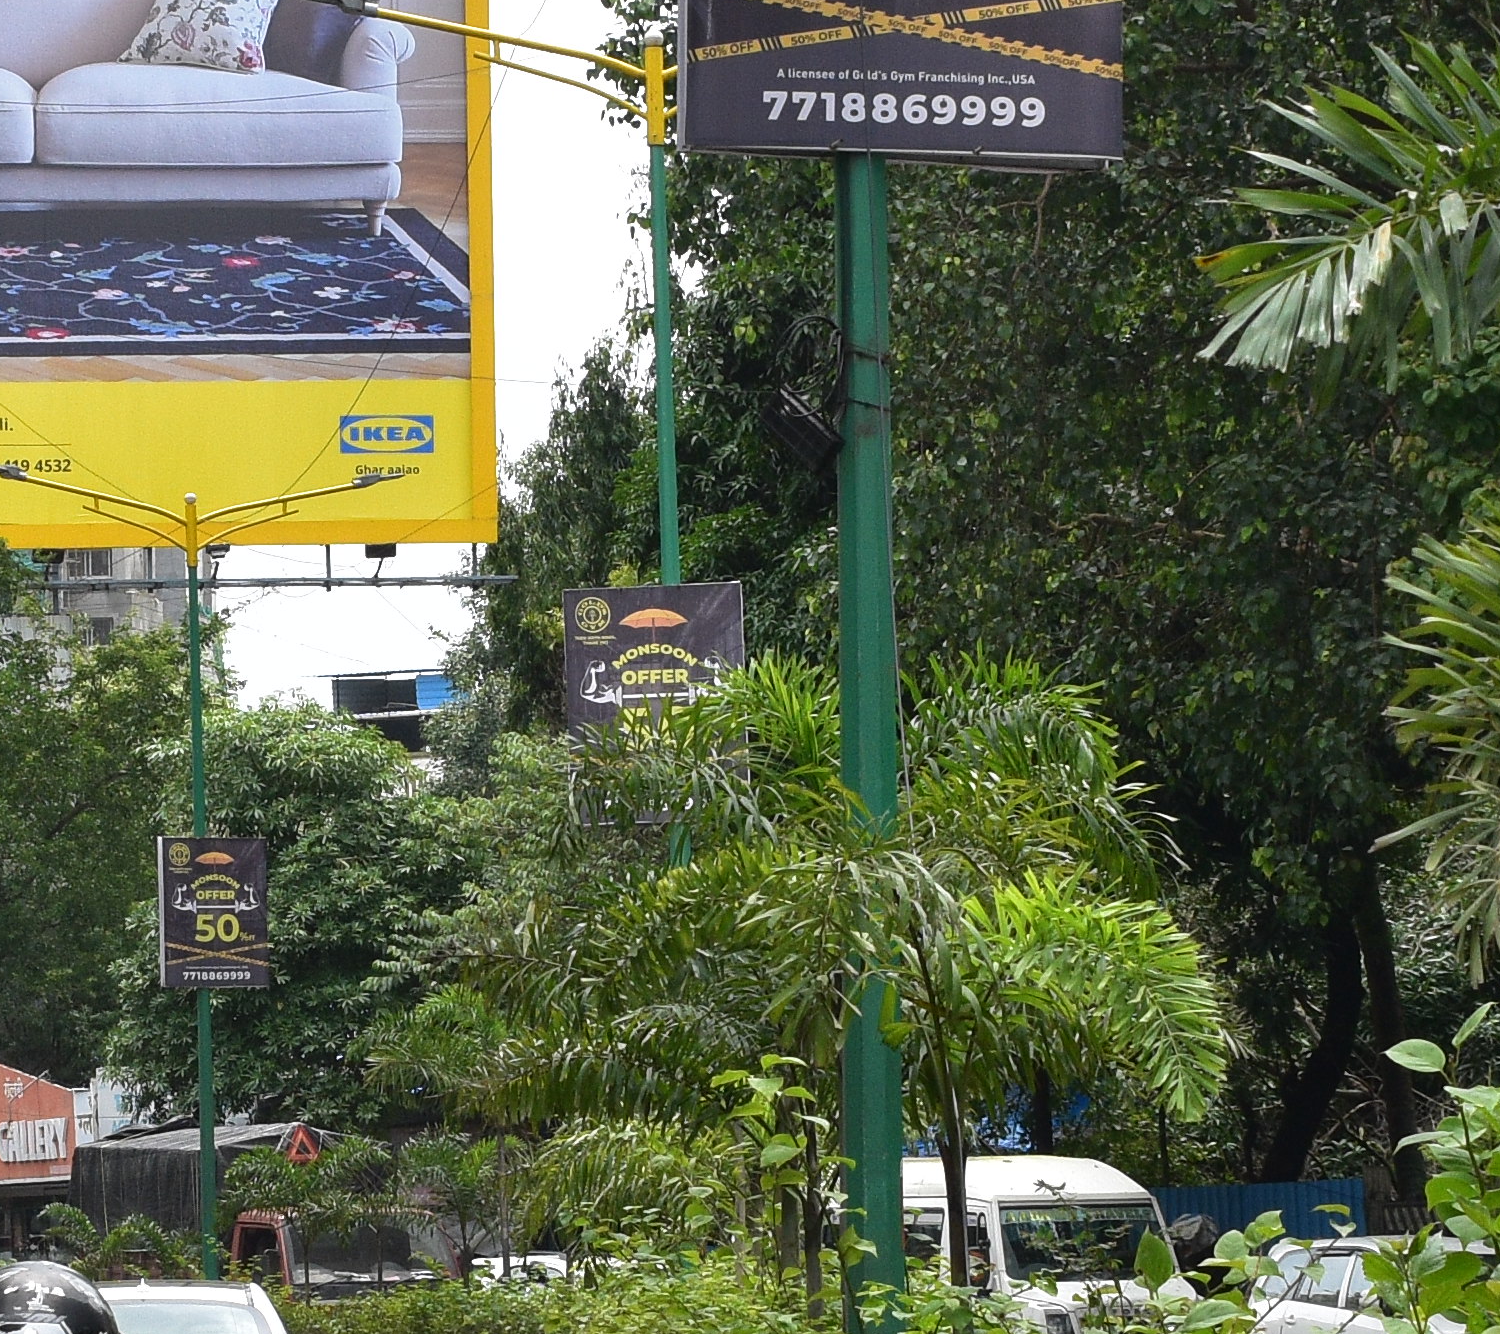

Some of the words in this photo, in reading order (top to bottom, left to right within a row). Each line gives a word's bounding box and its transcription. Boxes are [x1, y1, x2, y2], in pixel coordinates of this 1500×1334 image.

[978, 6, 1004, 20] 50%
[1006, 3, 1030, 15] OFF
[790, 33, 815, 47] 50%
[818, 29, 843, 41] OFF
[702, 46, 728, 59] 50%
[730, 42, 754, 55] OFF
[776, 68, 786, 78] A
[788, 68, 835, 80] licensee
[838, 69, 849, 80] of
[890, 71, 915, 83] Gym
[918, 72, 986, 86] Franchising
[762, 91, 1046, 128] 7718869999
[349, 426, 427, 442] IKEA
[34, 459, 72, 473] 4532
[355, 464, 384, 475] Ghar
[611, 643, 700, 670] MONSOON
[621, 668, 689, 686] OFFER
[196, 890, 236, 900] OFFER
[195, 914, 240, 943] 50
[182, 971, 251, 981] 7718869999
